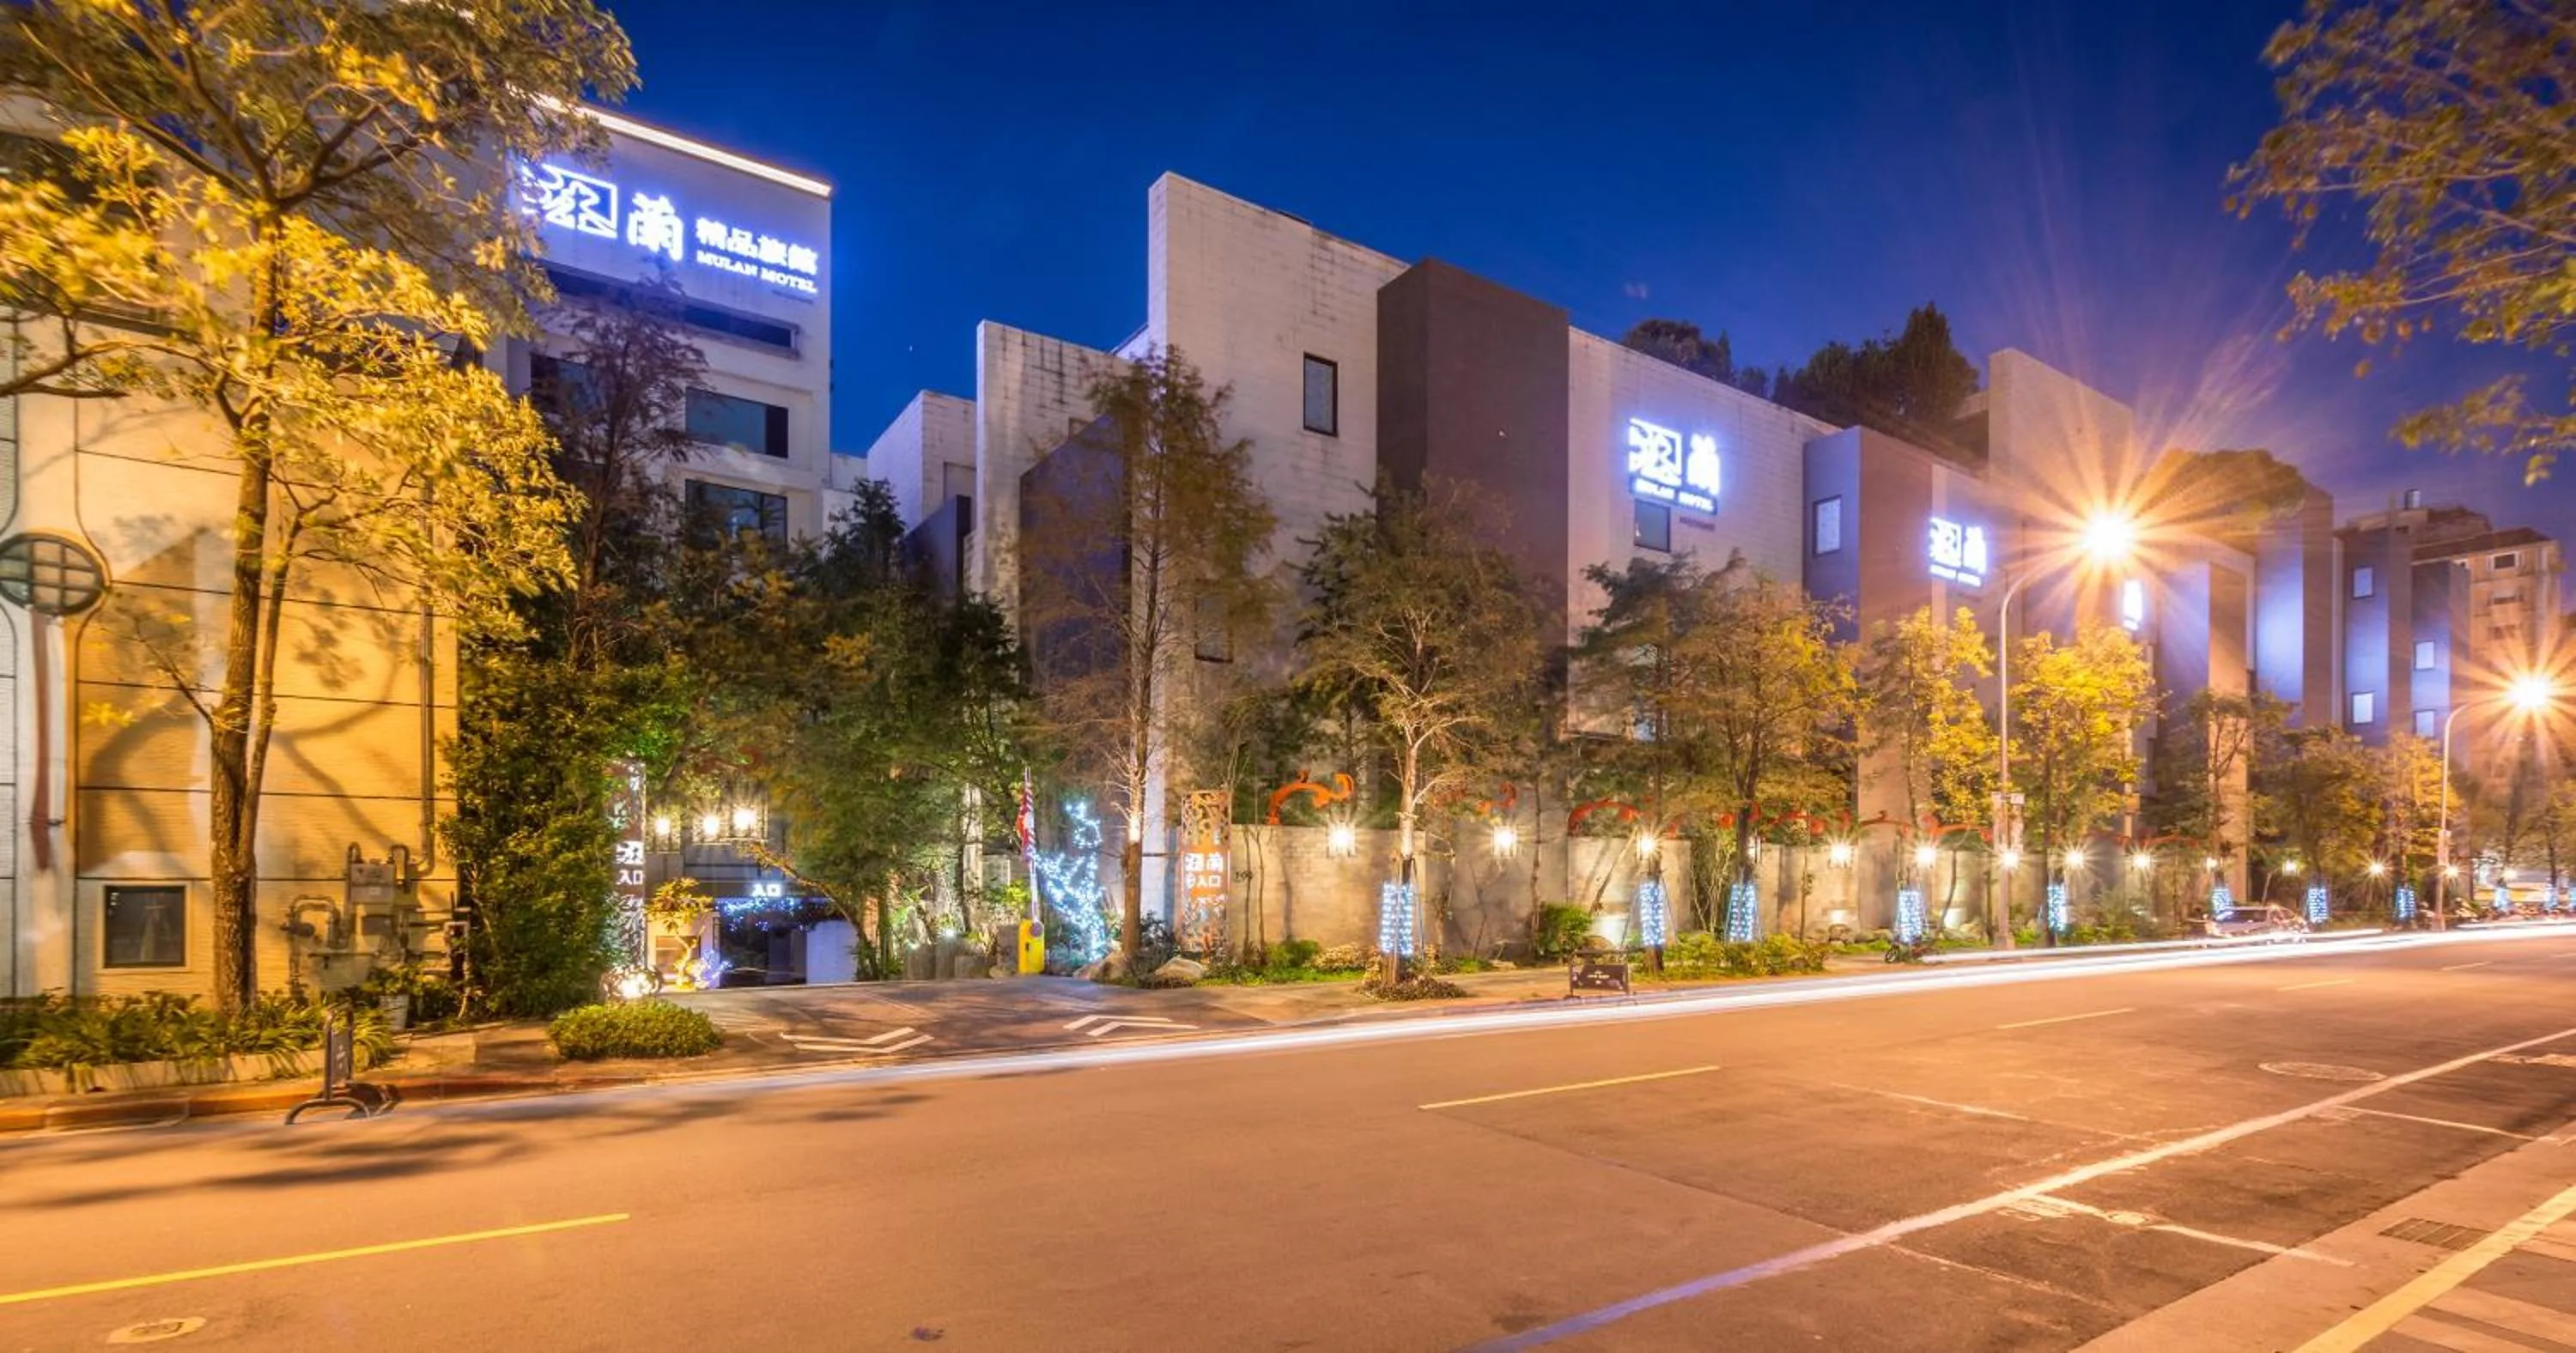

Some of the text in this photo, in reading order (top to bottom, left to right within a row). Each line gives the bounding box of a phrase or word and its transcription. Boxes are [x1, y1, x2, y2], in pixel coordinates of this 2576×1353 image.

[696, 250, 817, 294] MULAN MOTEL
[616, 869, 643, 885] 入口
[751, 883, 781, 898] 入口
